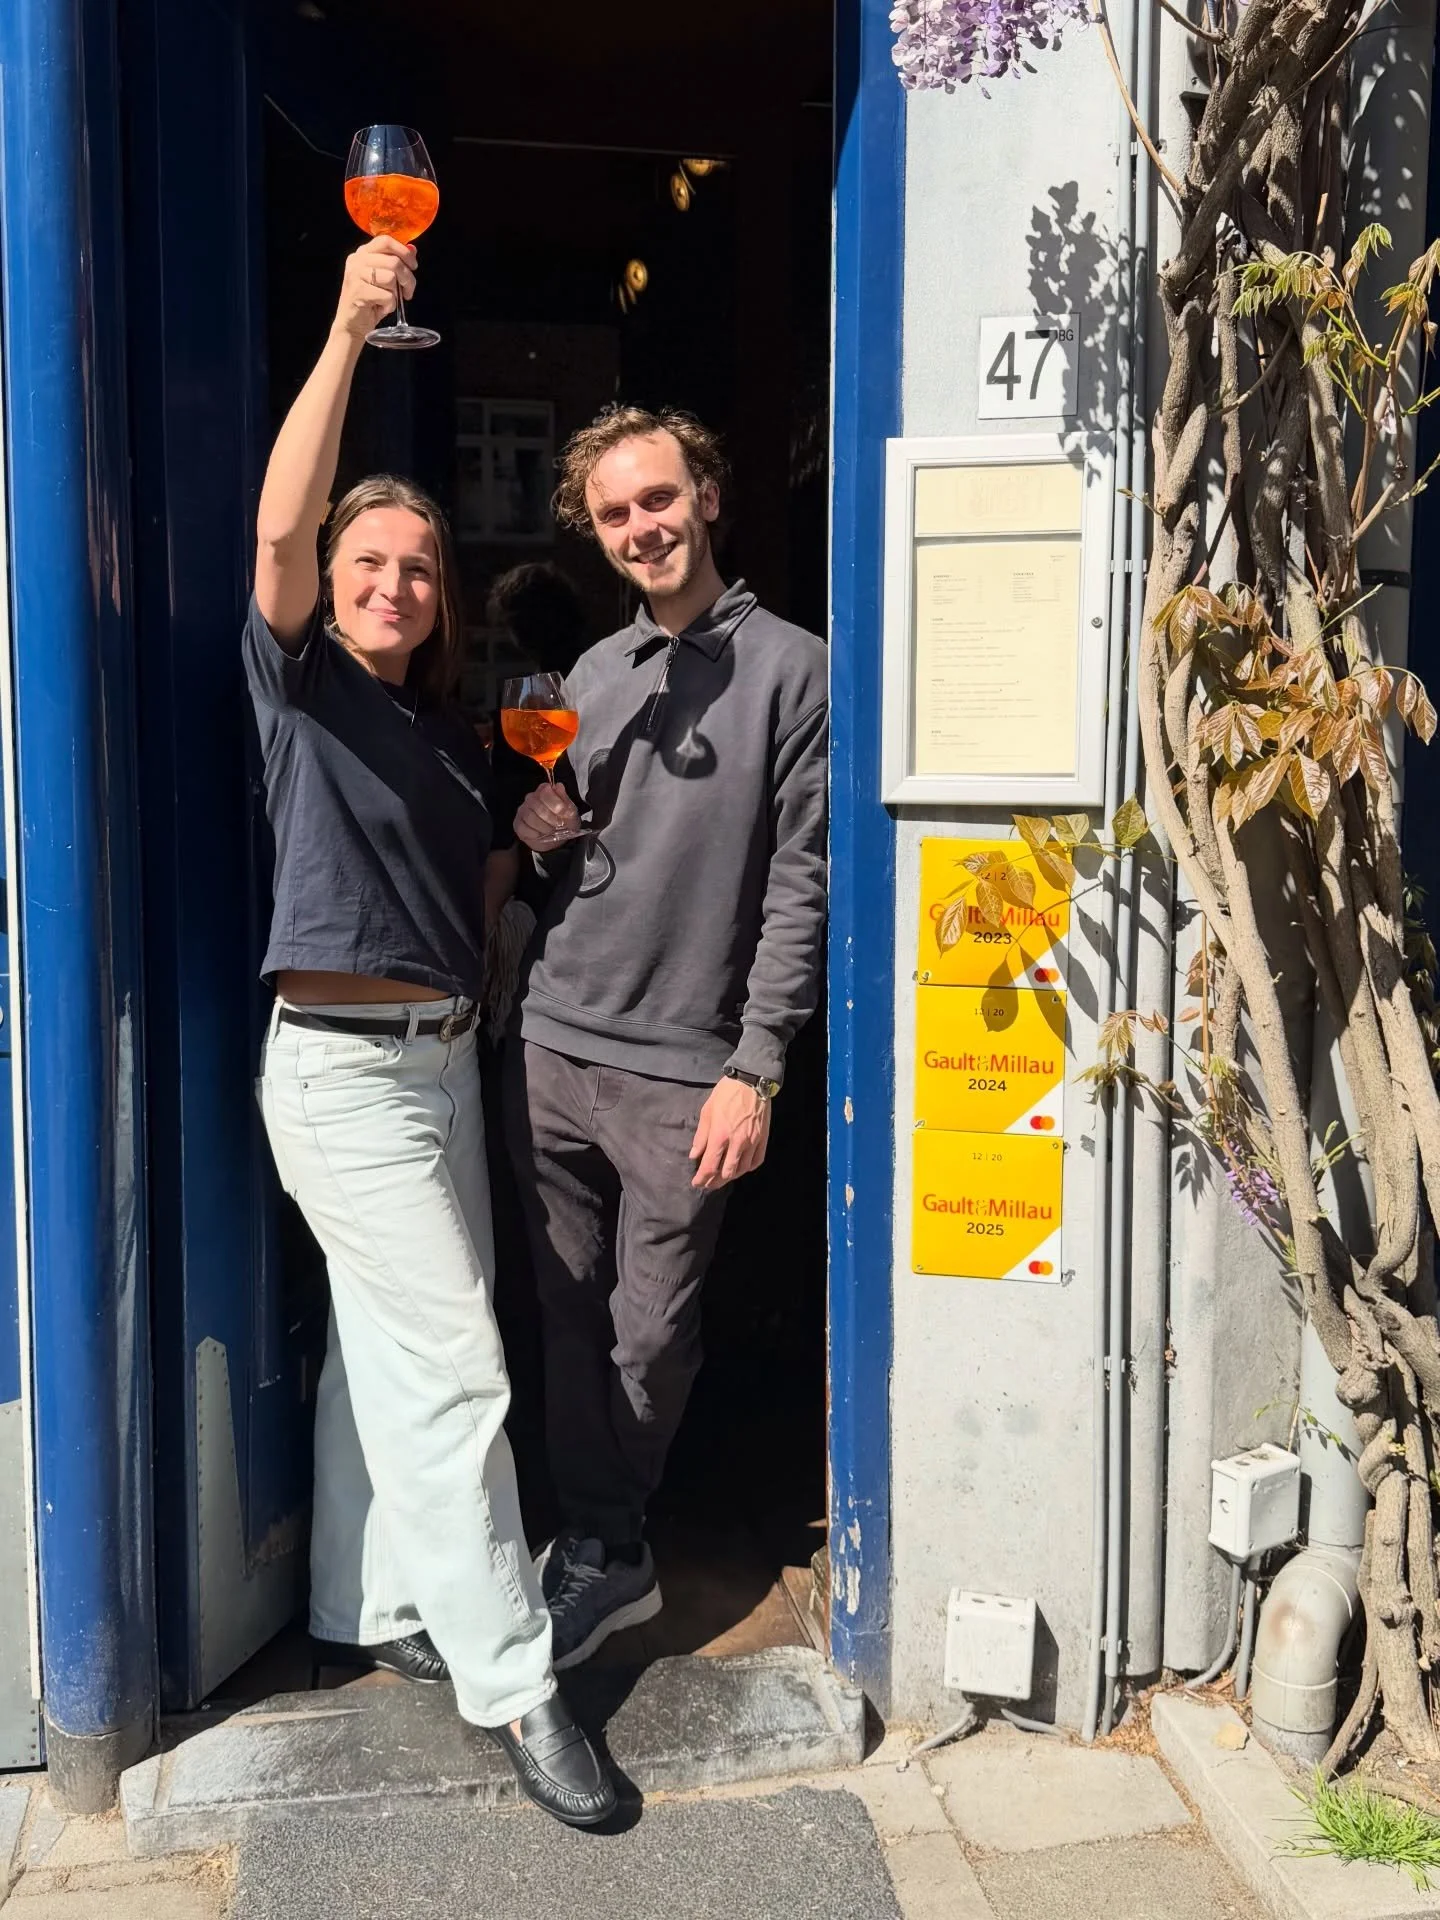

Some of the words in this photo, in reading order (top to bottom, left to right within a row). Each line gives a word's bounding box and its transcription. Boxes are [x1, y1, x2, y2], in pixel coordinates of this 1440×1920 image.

[986, 330, 1058, 401] 47
[1058, 329, 1074, 342] BG
[973, 931, 1012, 945] 2023
[993, 1008, 1004, 1018] 20
[968, 1078, 1008, 1092] 2024
[972, 1152, 983, 1161] 12
[991, 1153, 1003, 1162] 20
[966, 1221, 1005, 1236] 2025
